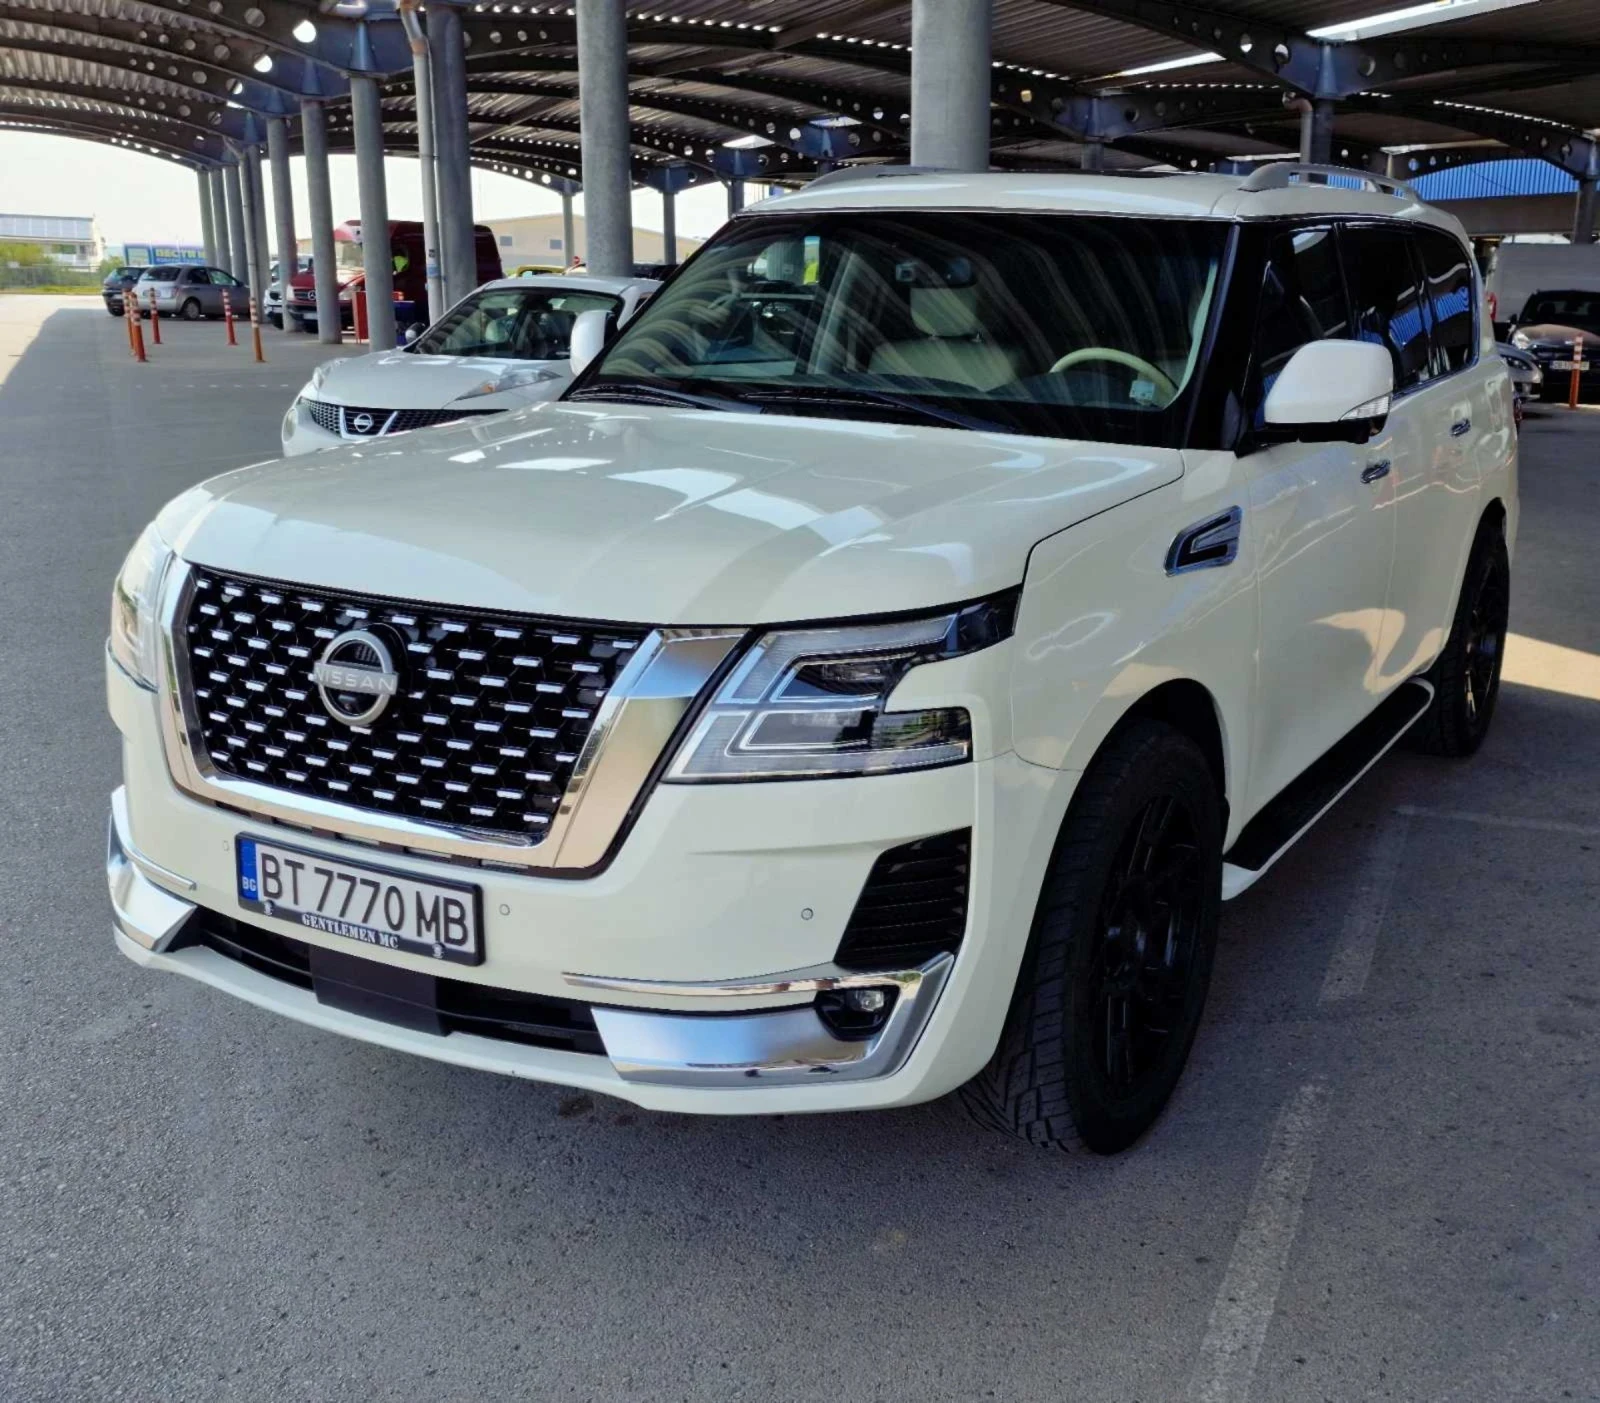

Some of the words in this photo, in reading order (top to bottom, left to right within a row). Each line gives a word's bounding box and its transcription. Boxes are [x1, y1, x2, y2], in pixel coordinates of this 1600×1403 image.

[315, 667, 394, 691] NISSAN
[242, 876, 257, 892] BG
[261, 853, 304, 906] BT
[314, 866, 405, 932] 7770
[416, 890, 468, 947] MB
[302, 911, 376, 943] GENTLEMEN
[379, 930, 399, 949] MC
